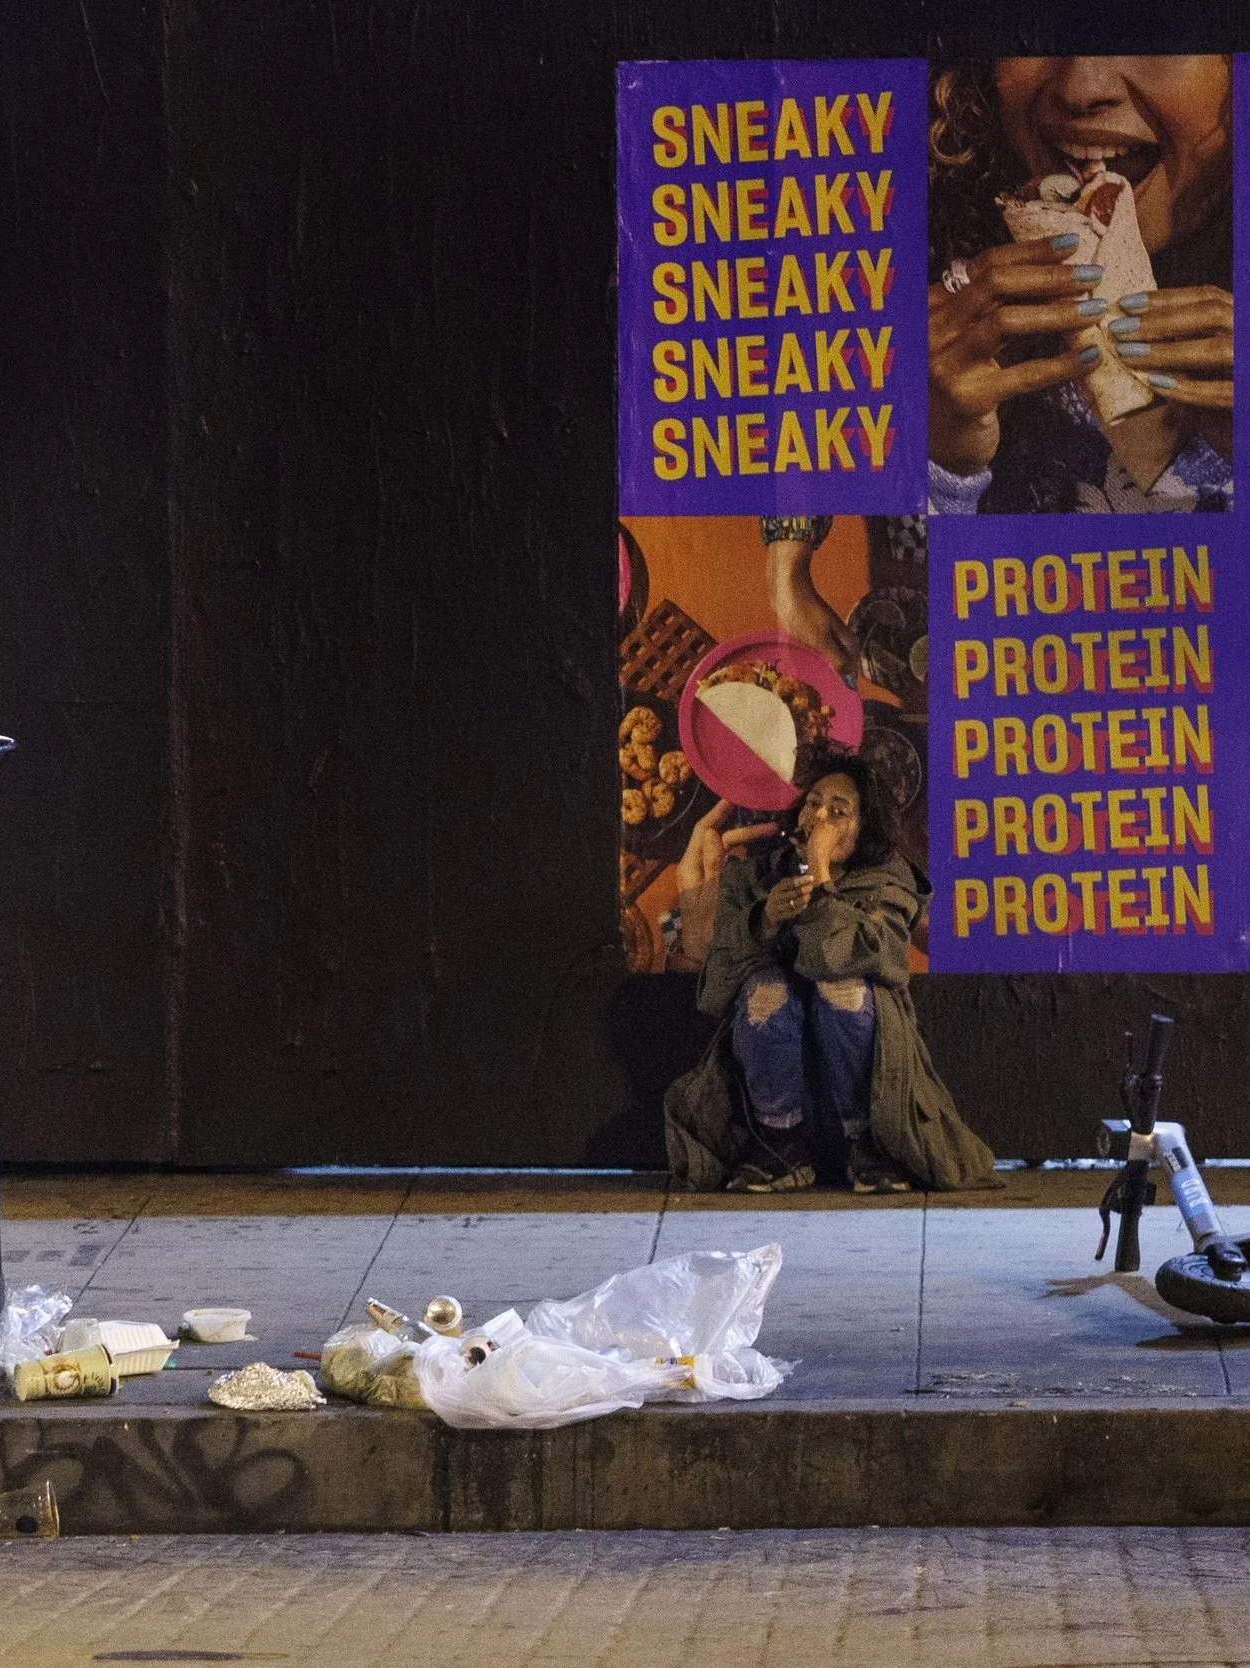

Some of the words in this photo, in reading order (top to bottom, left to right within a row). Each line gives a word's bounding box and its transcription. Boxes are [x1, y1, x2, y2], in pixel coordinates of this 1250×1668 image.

[652, 91, 894, 169] SNEAKY
[652, 169, 894, 247] SNEAKY
[652, 247, 894, 325] SNEAKY
[652, 326, 894, 403] SNEAKY
[652, 404, 894, 481] SNEAKY
[953, 545, 1213, 620] PROTEIN
[953, 625, 1213, 699] PROTEIN
[953, 704, 1213, 779] PROTEIN
[953, 784, 1213, 858] PROTEIN
[953, 864, 1213, 938] PROTEIN
